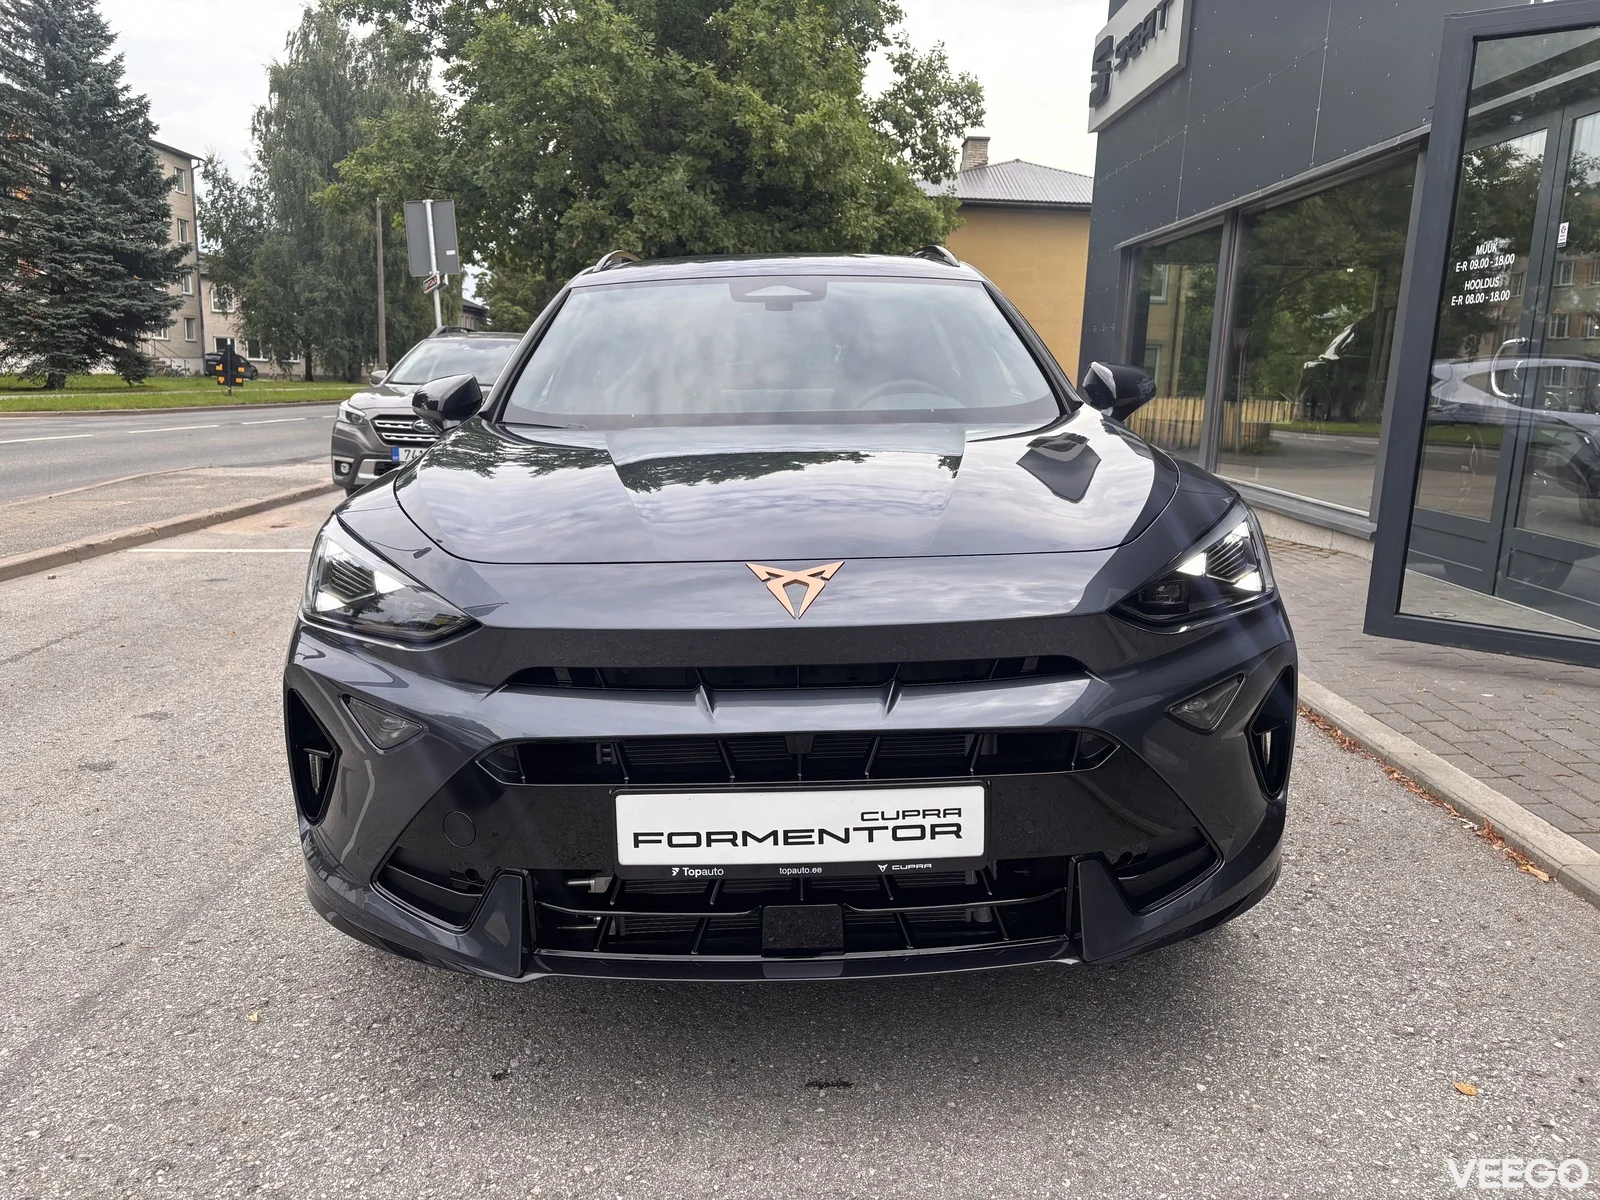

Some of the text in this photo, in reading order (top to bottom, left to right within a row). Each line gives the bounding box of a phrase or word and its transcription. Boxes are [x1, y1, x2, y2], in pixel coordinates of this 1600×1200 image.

[1113, 0, 1174, 72] SEAT
[1475, 240, 1498, 255] MÜÜK
[1455, 261, 1467, 272] E-R
[1469, 257, 1489, 270] 09.00
[1494, 253, 1515, 267] 18.00
[1464, 276, 1499, 290] HOOLDUS
[1451, 295, 1463, 306] E-R
[1465, 292, 1485, 304] 08.00
[1489, 289, 1510, 302] 18.00
[860, 807, 962, 821] CUPRA
[633, 823, 963, 849] FORMENTOR
[682, 866, 725, 878] Topauto
[779, 865, 823, 875] topauto.ee
